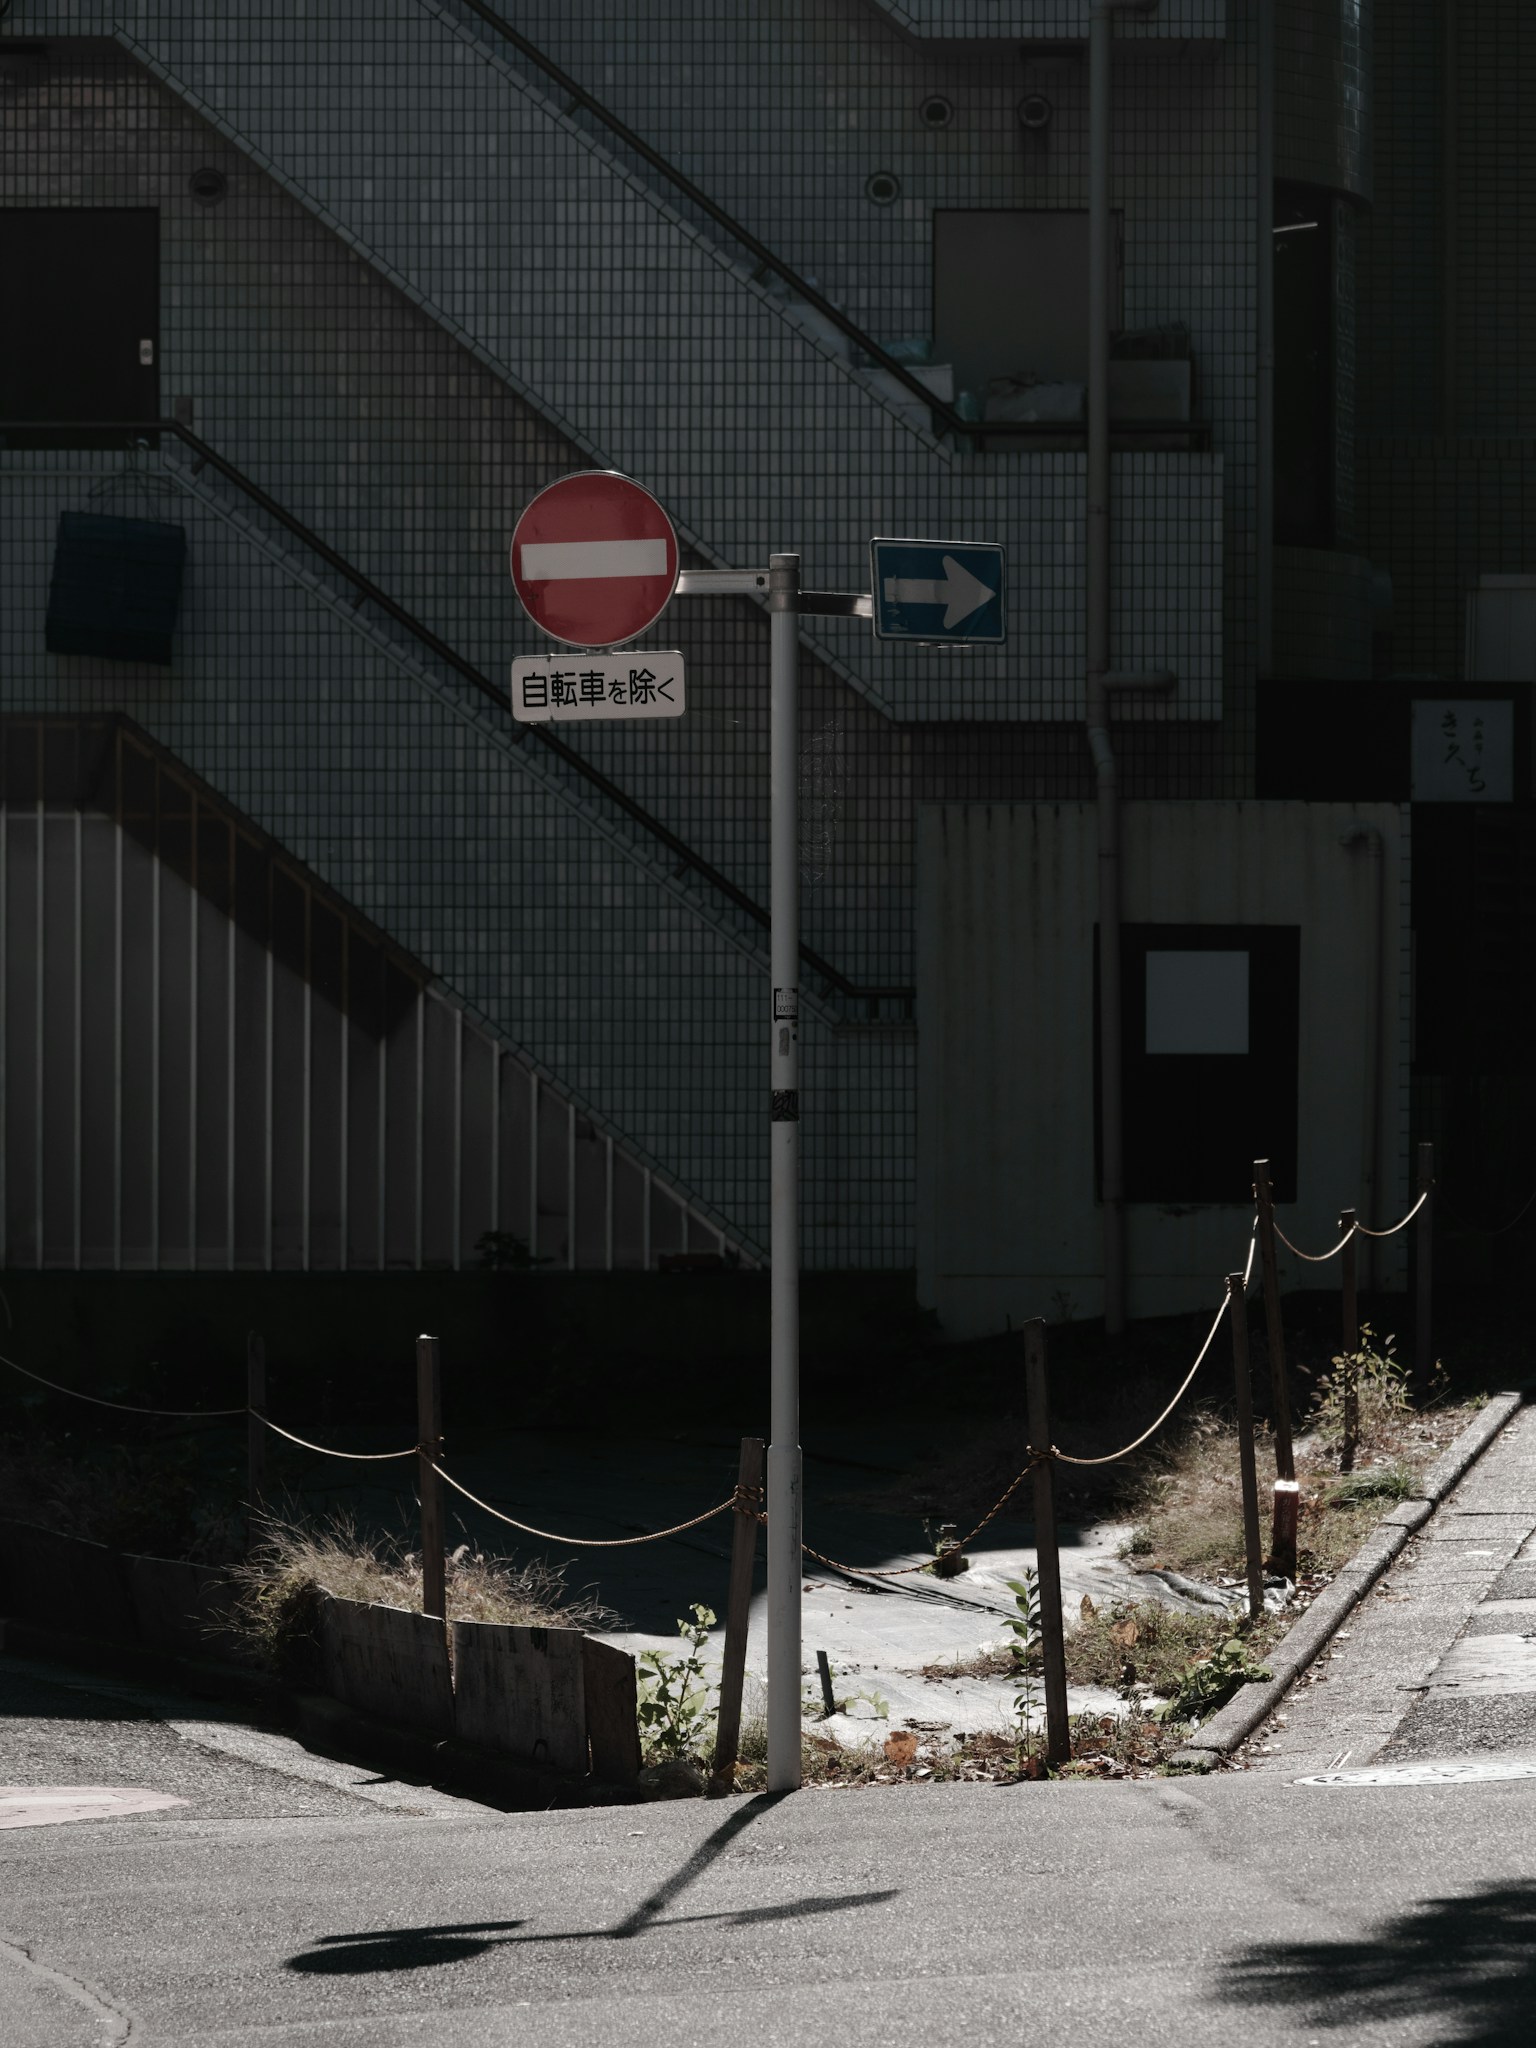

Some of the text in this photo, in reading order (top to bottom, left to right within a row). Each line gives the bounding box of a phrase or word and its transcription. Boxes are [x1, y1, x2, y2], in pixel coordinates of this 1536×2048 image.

[522, 668, 675, 708] 自転車を除く
